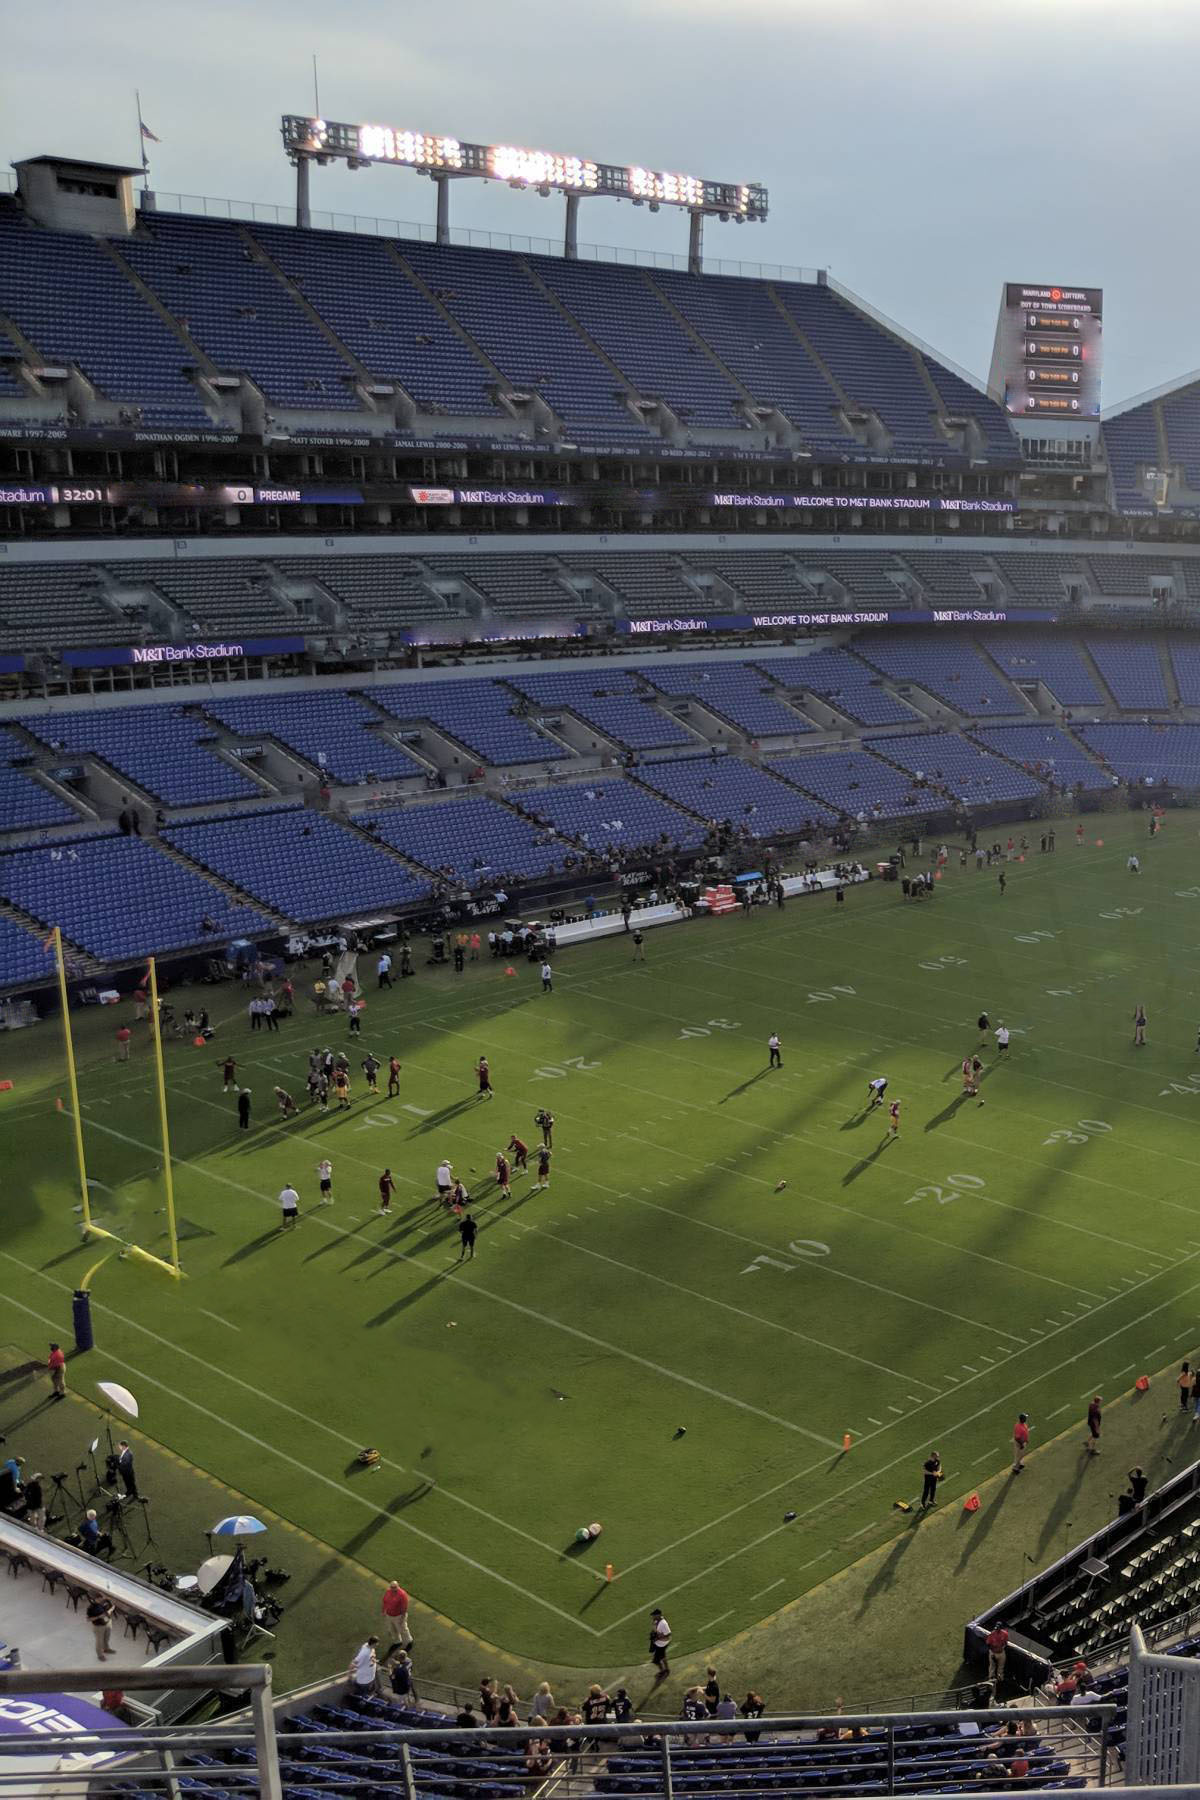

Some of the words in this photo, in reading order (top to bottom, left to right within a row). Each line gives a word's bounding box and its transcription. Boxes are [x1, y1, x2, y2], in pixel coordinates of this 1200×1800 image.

[1030, 316, 1037, 326] 0
[1073, 318, 1079, 328] 0
[1030, 343, 1036, 353] 0
[1073, 345, 1079, 355] 0
[1030, 370, 1036, 380] 0
[1072, 372, 1078, 382] 0
[1029, 398, 1035, 408] 0
[1072, 400, 1078, 409] 0
[135, 432, 173, 441] JONATHAN
[174, 433, 200, 441] OGDEN
[63, 489, 102, 501] 32:01
[260, 490, 301, 501] PREGAME
[460, 491, 485, 503] M&T
[485, 491, 507, 503] Bank
[507, 491, 544, 504] Stadium
[714, 494, 735, 505] M&T
[735, 495, 754, 506] Bank
[754, 495, 784, 506] Stadium
[794, 496, 834, 506] WELCOME
[835, 497, 848, 507] TO
[849, 498, 868, 507] M&T
[869, 498, 893, 508] BANK
[894, 499, 930, 508] STADIUM
[941, 500, 961, 510] M&T
[961, 500, 981, 511] Bank
[981, 501, 1013, 511] Stadium
[753, 615, 797, 626] WELCOME
[798, 615, 811, 624] TO
[811, 614, 830, 624] M&T
[831, 613, 852, 623] BANK
[854, 612, 888, 623] STADIUM
[933, 610, 953, 621] M&T
[953, 611, 973, 620] Bank
[973, 610, 1006, 620] Stadium
[630, 621, 652, 632] M&T
[652, 620, 674, 631] Bank
[674, 619, 707, 630] Stadium
[133, 647, 165, 662] M&T
[166, 646, 195, 660] Bank
[195, 644, 243, 658] Stadium
[1050, 1120, 1113, 1144] 30
[914, 1174, 985, 1204] 20
[752, 1239, 830, 1272] 10
